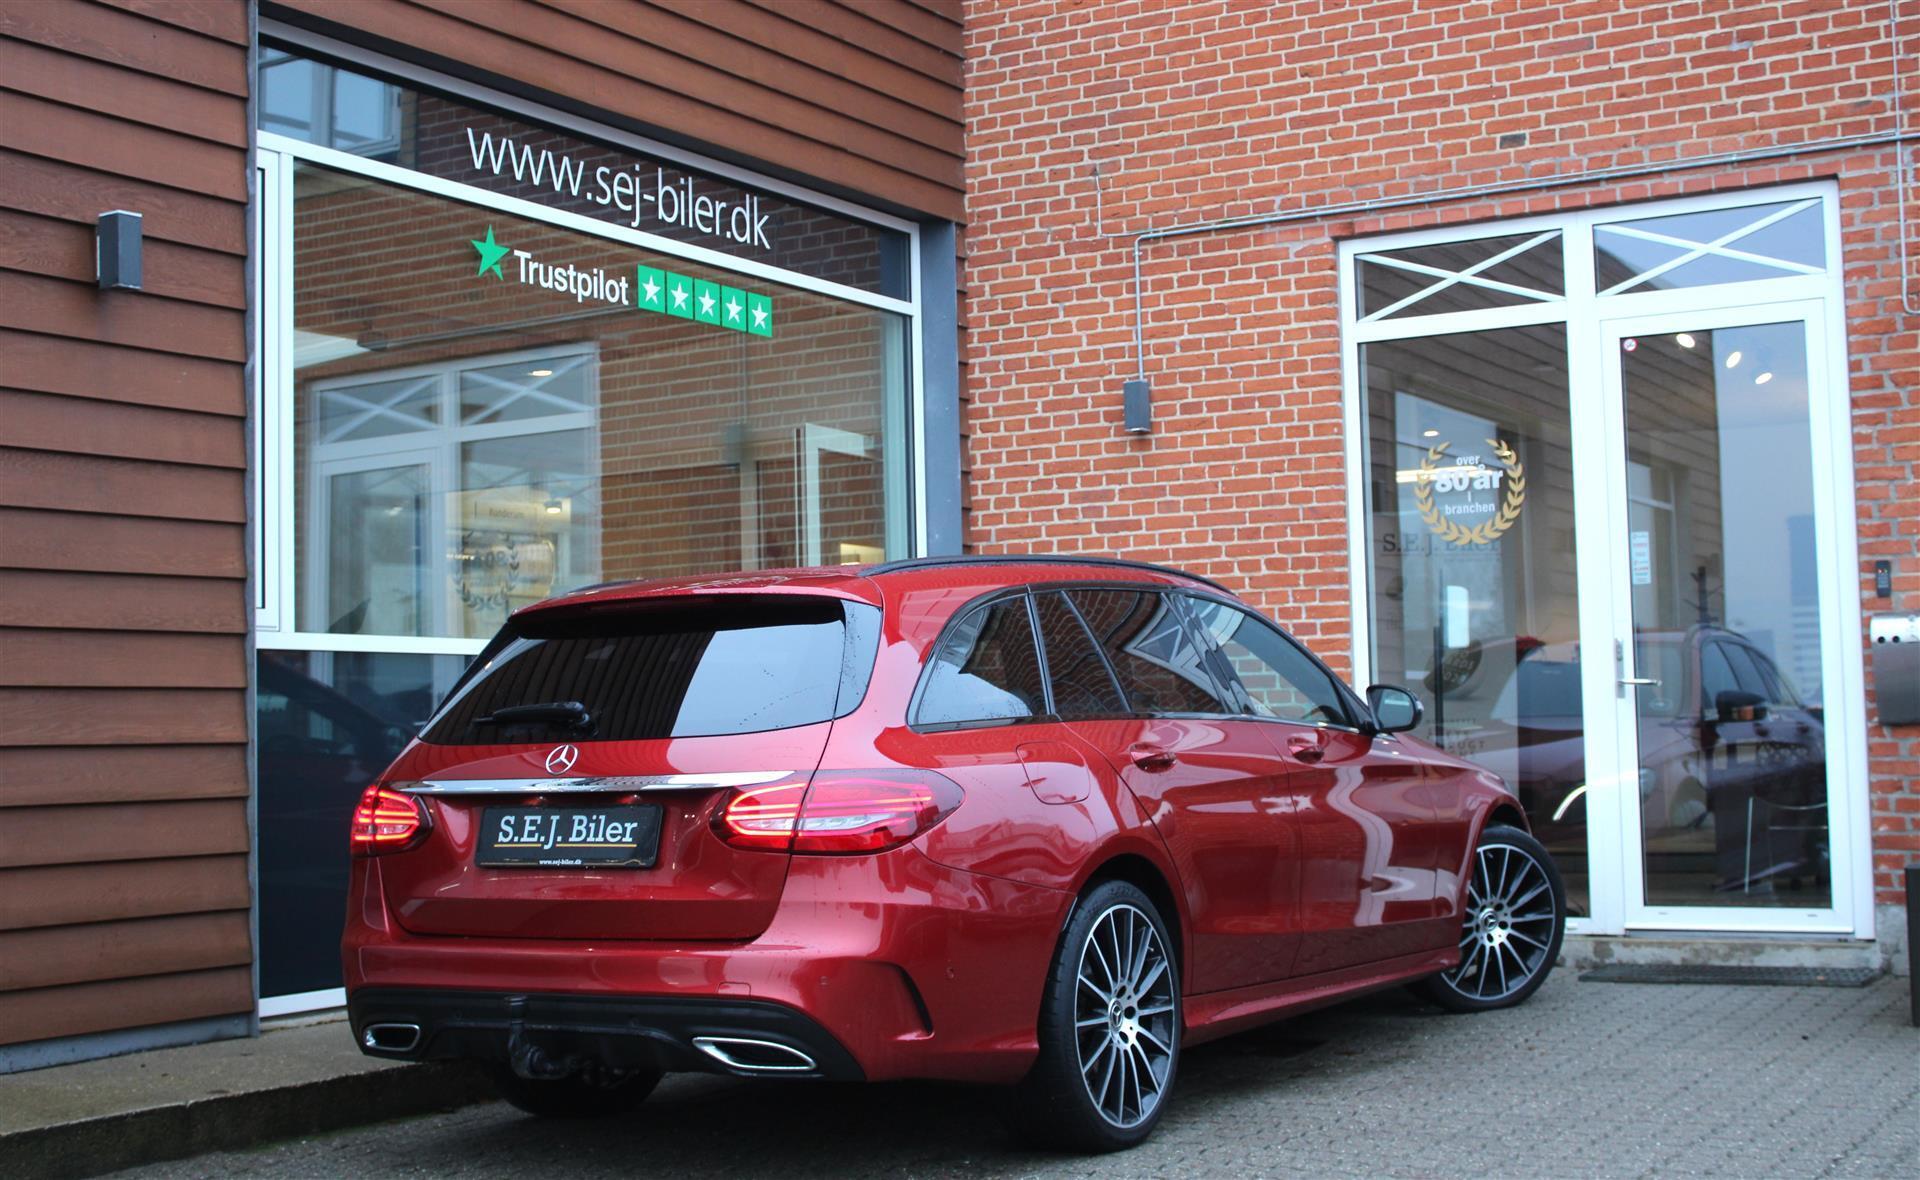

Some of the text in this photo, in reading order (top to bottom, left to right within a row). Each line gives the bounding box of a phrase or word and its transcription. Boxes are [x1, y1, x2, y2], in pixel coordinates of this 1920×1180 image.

[466, 127, 771, 250] www.sej-biler.dk
[513, 249, 629, 305] Trustpilot
[1456, 455, 1480, 466] over
[1435, 464, 1504, 493] 80 år
[1445, 502, 1496, 515] branchen
[497, 815, 638, 850] S.E.J. Biler
